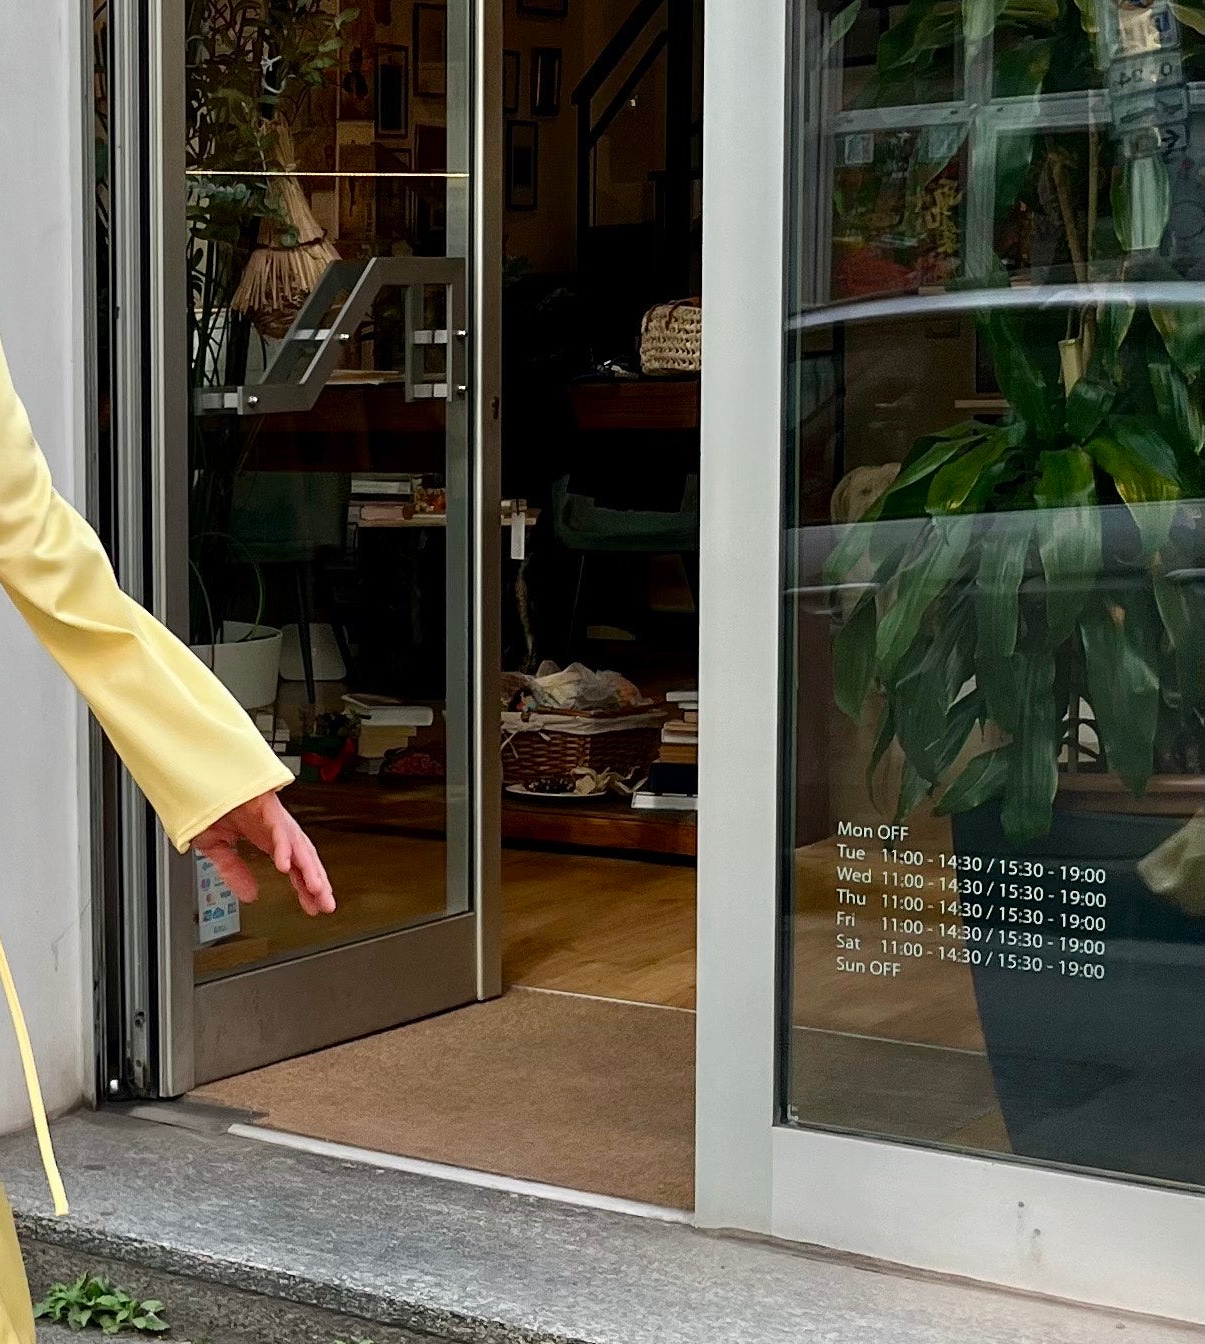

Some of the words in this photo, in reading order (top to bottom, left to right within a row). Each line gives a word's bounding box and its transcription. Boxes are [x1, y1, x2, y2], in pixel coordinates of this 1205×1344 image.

[837, 821, 873, 838] Mon
[877, 824, 909, 841] OFF
[836, 843, 866, 860] Tue
[882, 848, 923, 866] 11:00
[938, 854, 982, 872] 14:30
[999, 859, 1044, 878] 15:30
[1060, 866, 1106, 884] 19:00
[837, 866, 872, 884] Wed
[882, 871, 924, 889] 11:00
[939, 877, 983, 895] 14:30
[999, 883, 1044, 901] 15:30
[1060, 889, 1107, 907] 19:00
[836, 889, 866, 906] Thu
[882, 894, 924, 912] 11:00
[939, 900, 982, 918] 14:30
[999, 906, 1043, 925] 15:30
[1059, 913, 1106, 932] 19:00
[836, 911, 855, 927] Fri
[882, 917, 924, 935] 11:00
[938, 923, 982, 941] 14:30
[998, 930, 1043, 948] 15:30
[1059, 937, 1105, 955] 19:00
[836, 934, 861, 950] Sat
[881, 939, 923, 957] 11:00
[938, 946, 982, 964] 14:30
[998, 953, 1043, 972] 15:30
[1059, 960, 1105, 979] 19:00
[836, 956, 865, 973] Sun
[870, 961, 901, 977] OFF
